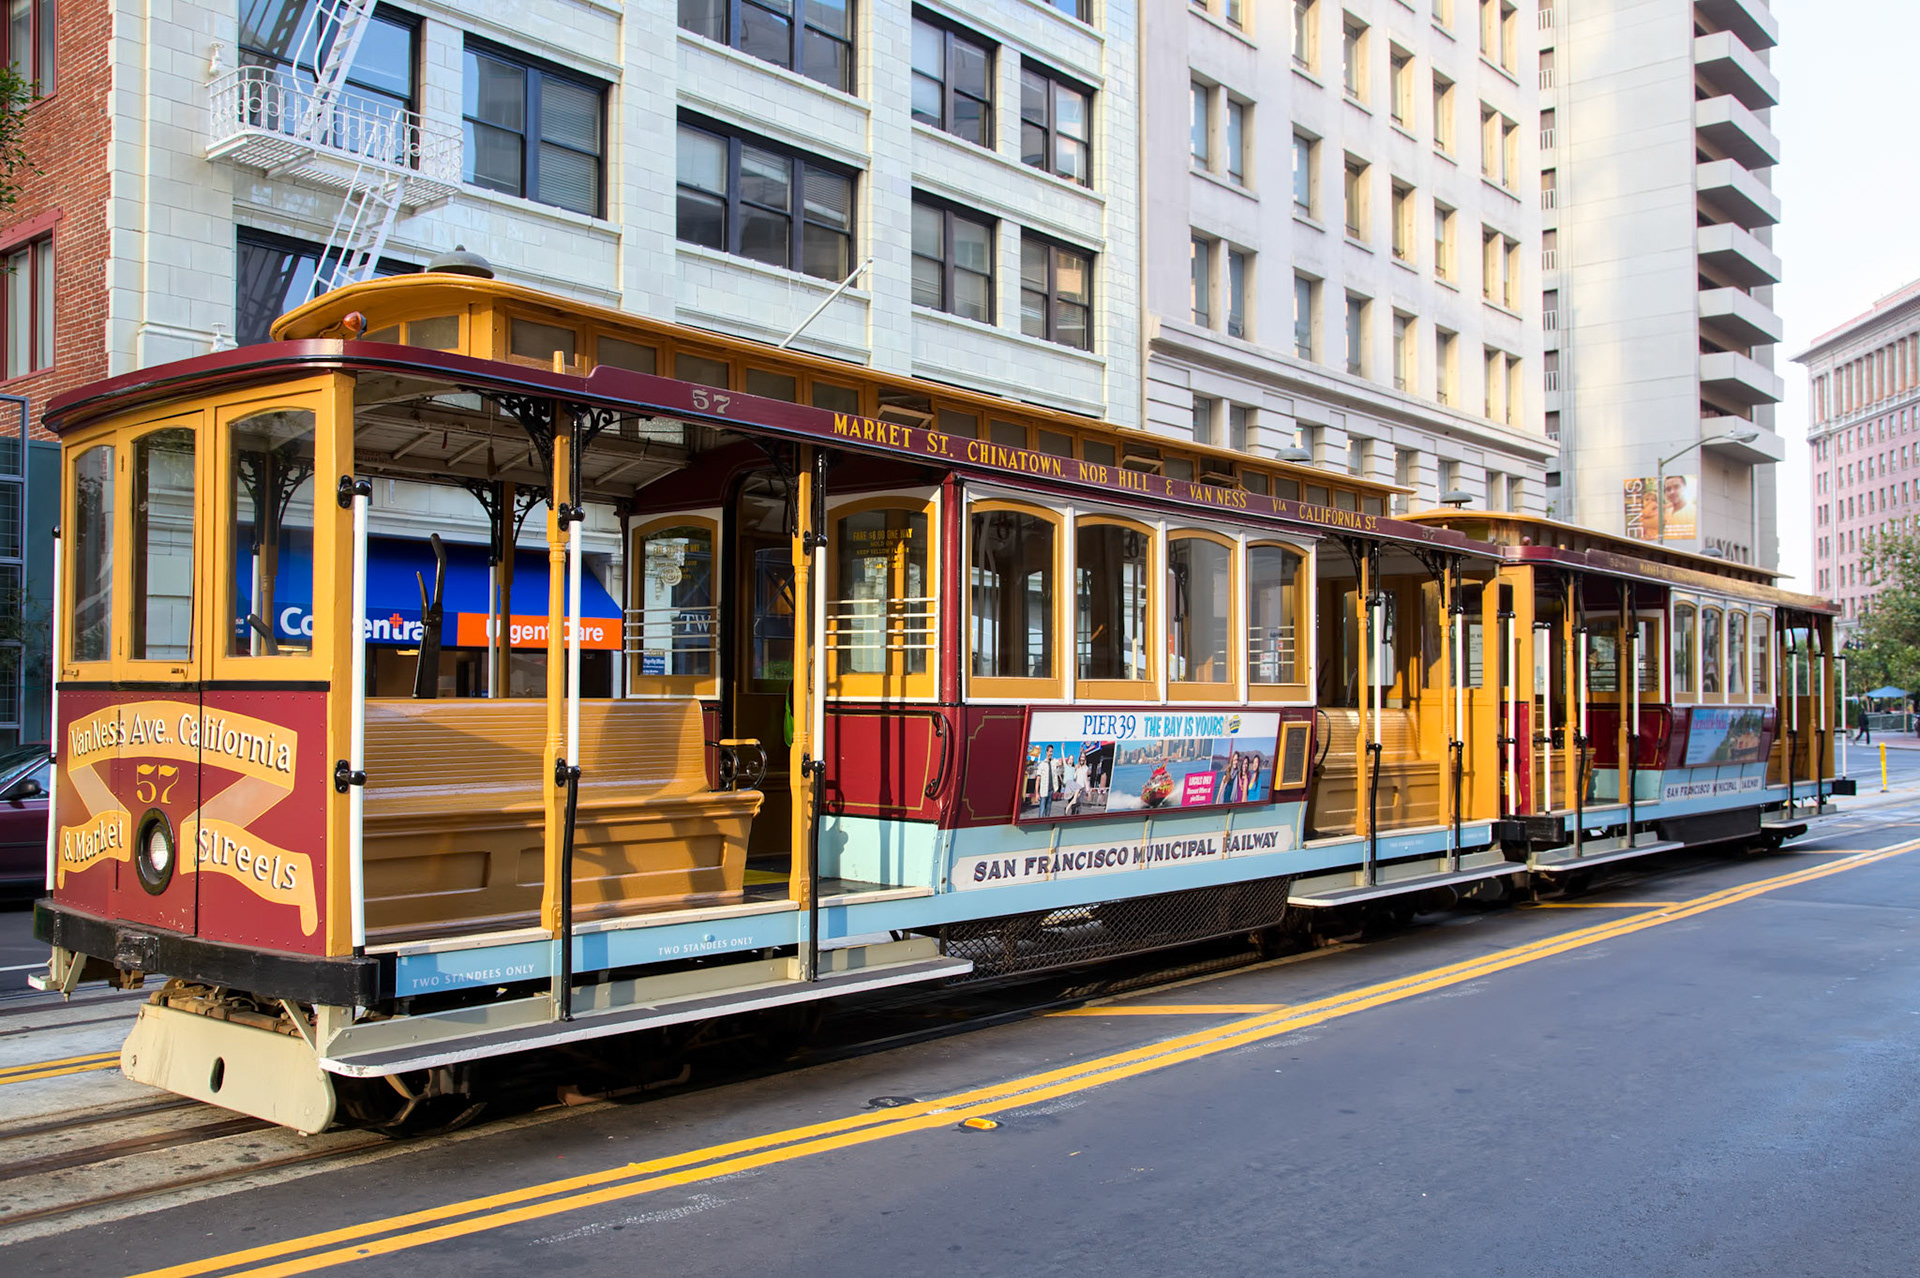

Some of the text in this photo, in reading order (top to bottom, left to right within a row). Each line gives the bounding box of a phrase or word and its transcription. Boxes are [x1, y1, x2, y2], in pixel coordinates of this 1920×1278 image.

[690, 389, 731, 414] 57
[833, 413, 912, 448] MARKET
[926, 433, 954, 457] ST.
[1079, 463, 1108, 485] NOB
[1118, 470, 1150, 492] HILL
[1165, 480, 1173, 497] &
[1189, 484, 1213, 505] VAN
[1216, 488, 1247, 509] NESS
[1299, 504, 1362, 530] CALIFORNIA
[1626, 480, 1644, 538] SHINE
[178, 712, 290, 774] California
[1144, 715, 1161, 738] THE
[1164, 715, 1183, 738] BAY
[1184, 715, 1194, 737] IS
[1195, 715, 1224, 738] YOURS
[135, 763, 179, 804] 57
[1667, 787, 1679, 798] SAN
[1740, 779, 1759, 789] AILWAY
[64, 818, 123, 863] & Market
[195, 826, 298, 890] Streets
[973, 831, 1279, 882] SAN FRANCISCO MUNICIPAL RAILWAY
[659, 936, 753, 956] TWO STANDEES ONLY
[412, 963, 535, 989] TWO STANDEES ONLY
